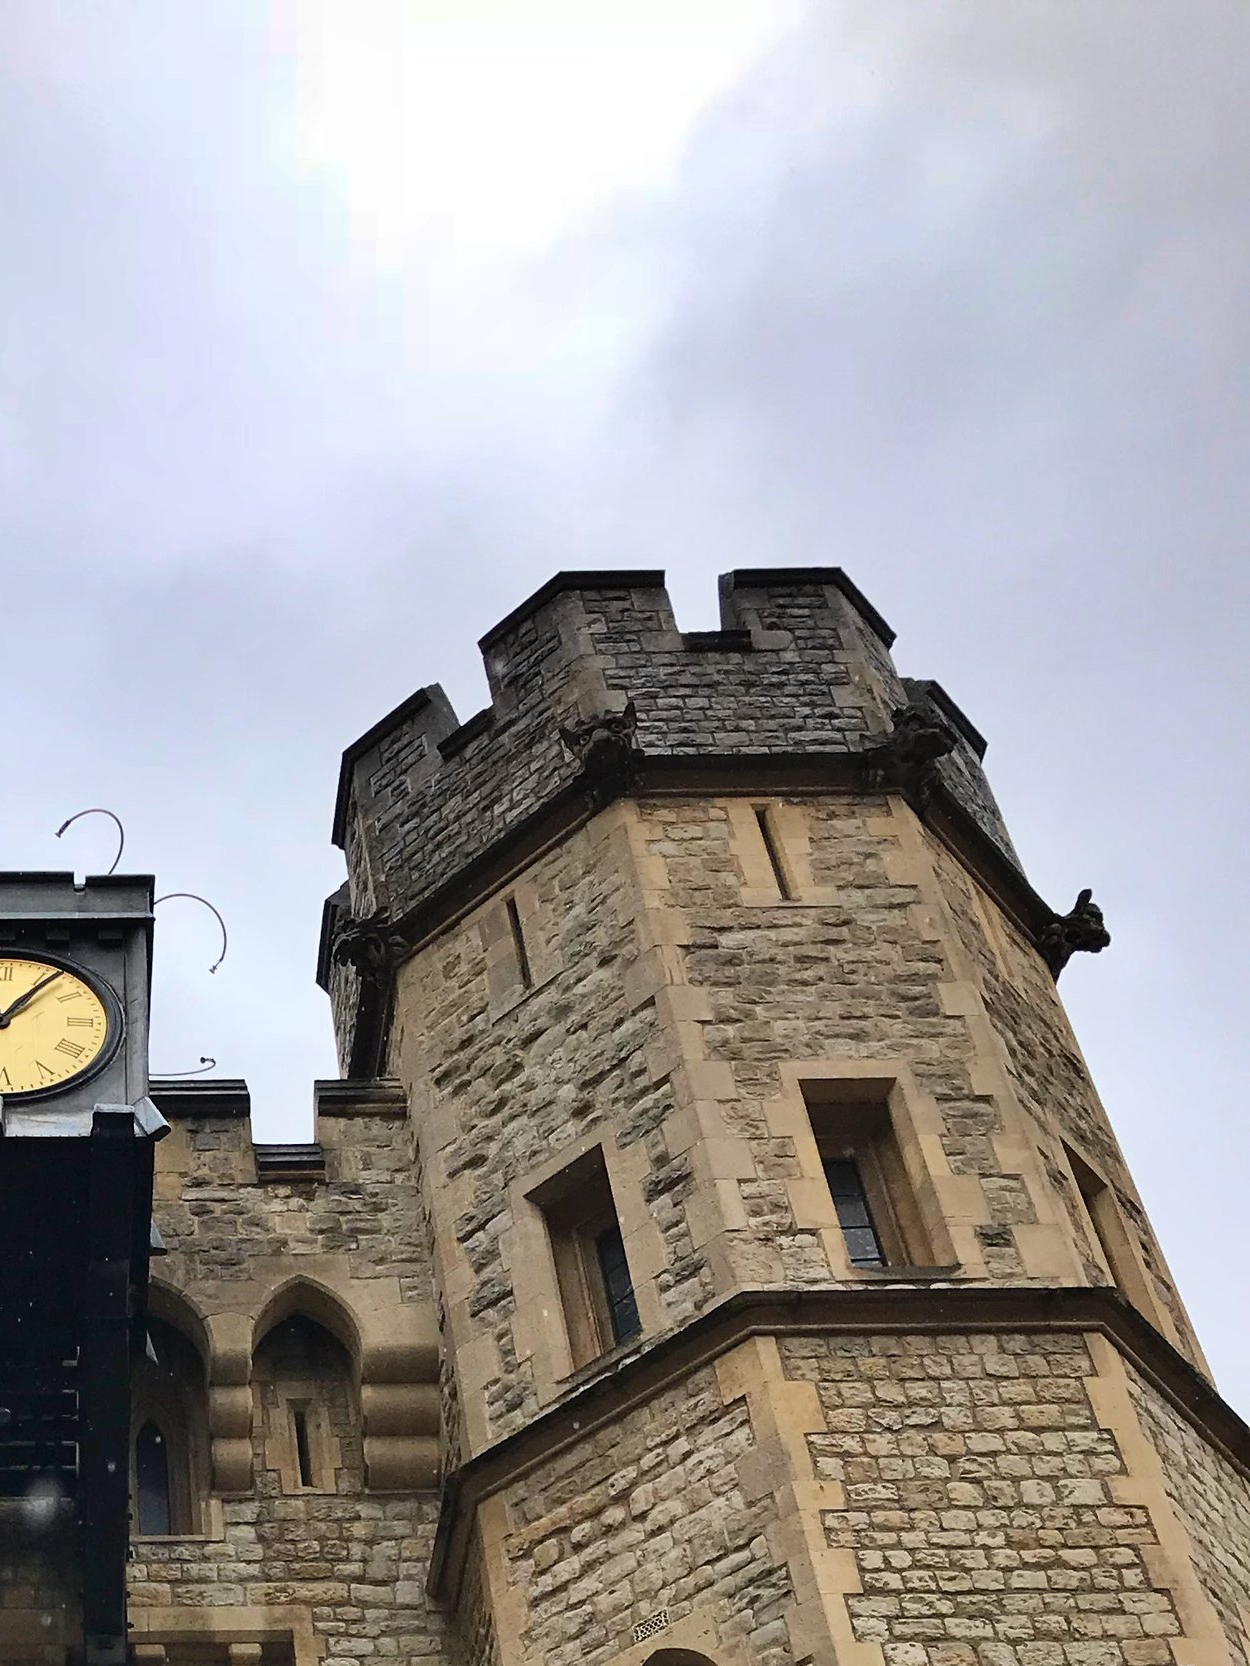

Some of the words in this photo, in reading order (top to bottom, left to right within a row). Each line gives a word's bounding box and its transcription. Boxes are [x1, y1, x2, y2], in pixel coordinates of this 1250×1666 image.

[56, 990, 83, 1004] II
[67, 1016, 94, 1028] III
[35, 1059, 56, 1079] V
